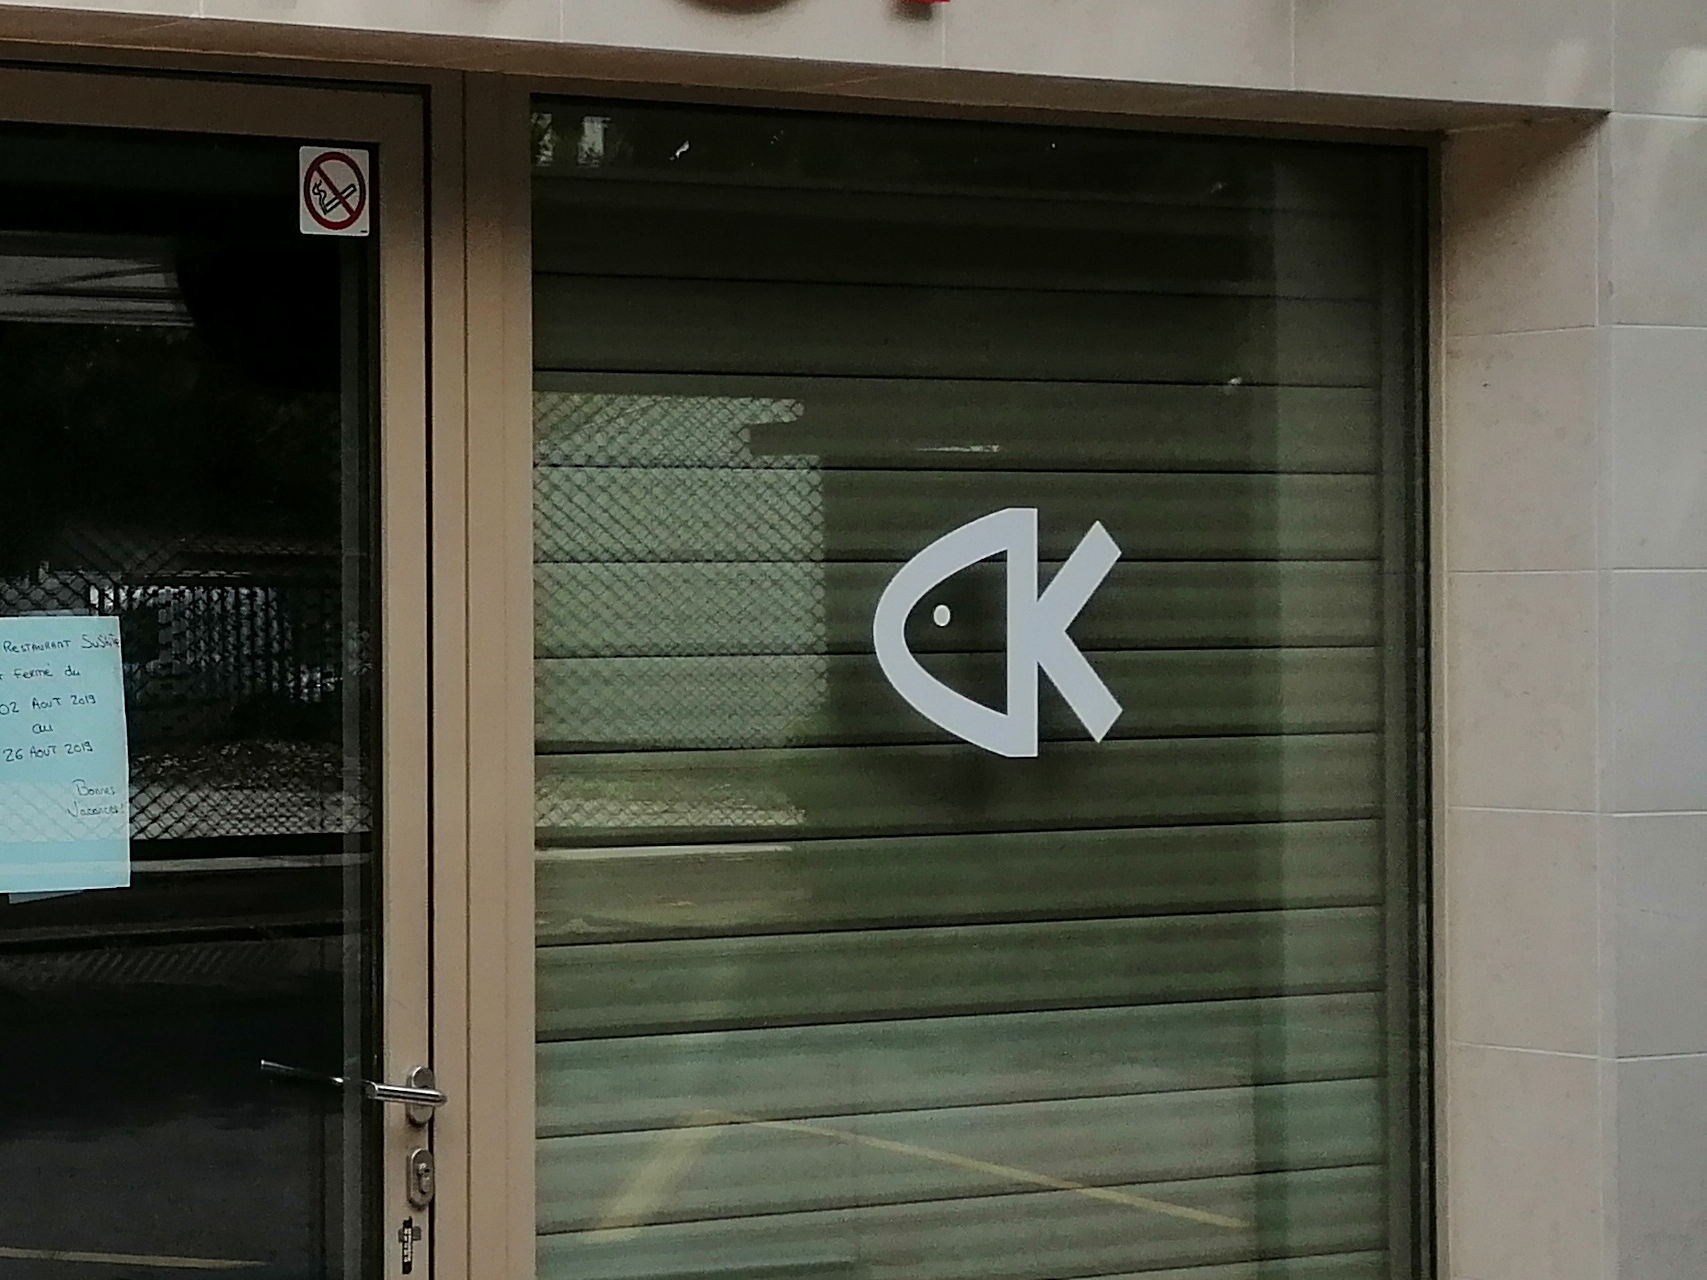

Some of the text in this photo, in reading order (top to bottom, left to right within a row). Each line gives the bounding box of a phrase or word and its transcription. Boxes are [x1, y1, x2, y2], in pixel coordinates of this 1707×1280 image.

[65, 665, 81, 676] du
[71, 694, 96, 705] 2019
[32, 724, 53, 734] au
[3, 749, 23, 762] 26
[65, 741, 93, 754] 2019
[72, 779, 115, 796] Bonnes
